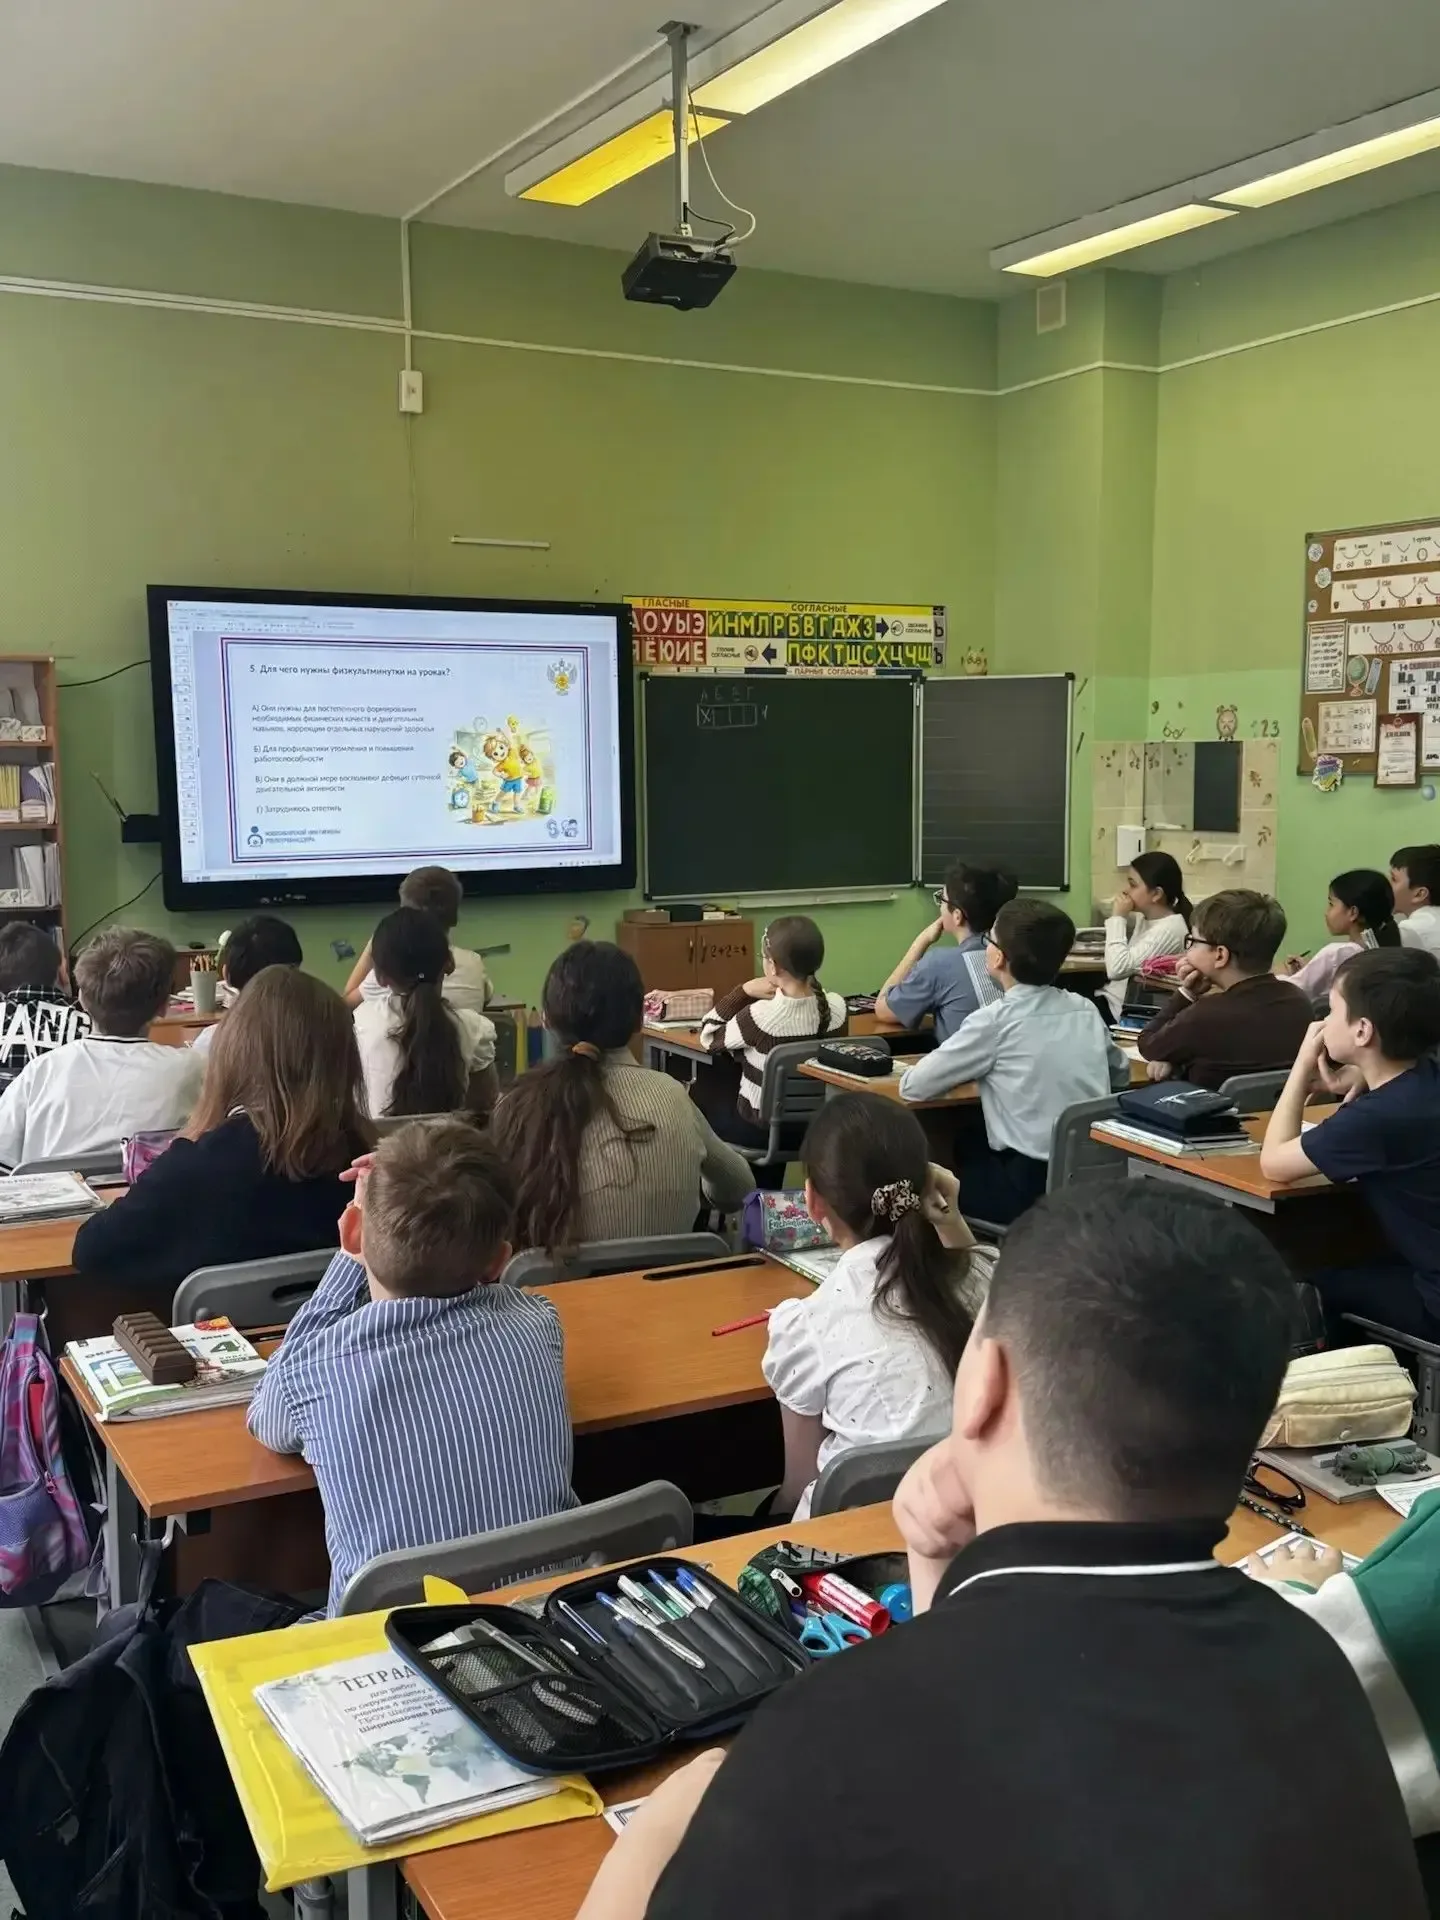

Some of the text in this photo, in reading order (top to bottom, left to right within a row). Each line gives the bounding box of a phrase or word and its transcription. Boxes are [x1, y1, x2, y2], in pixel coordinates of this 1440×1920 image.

[642, 598, 690, 608] ГЛАСНЫЕ
[791, 603, 848, 613] СОГЛАСНЫЕ
[1374, 641, 1425, 654] 1000 100
[259, 664, 277, 674] Для
[279, 666, 298, 674] чего
[301, 667, 330, 676] нужны
[332, 666, 405, 677] физкультминутки
[407, 668, 417, 676] на
[419, 668, 450, 677] уроках?
[0, 1001, 92, 1063] ANG
[339, 1665, 417, 1692] ТЕТРАД
